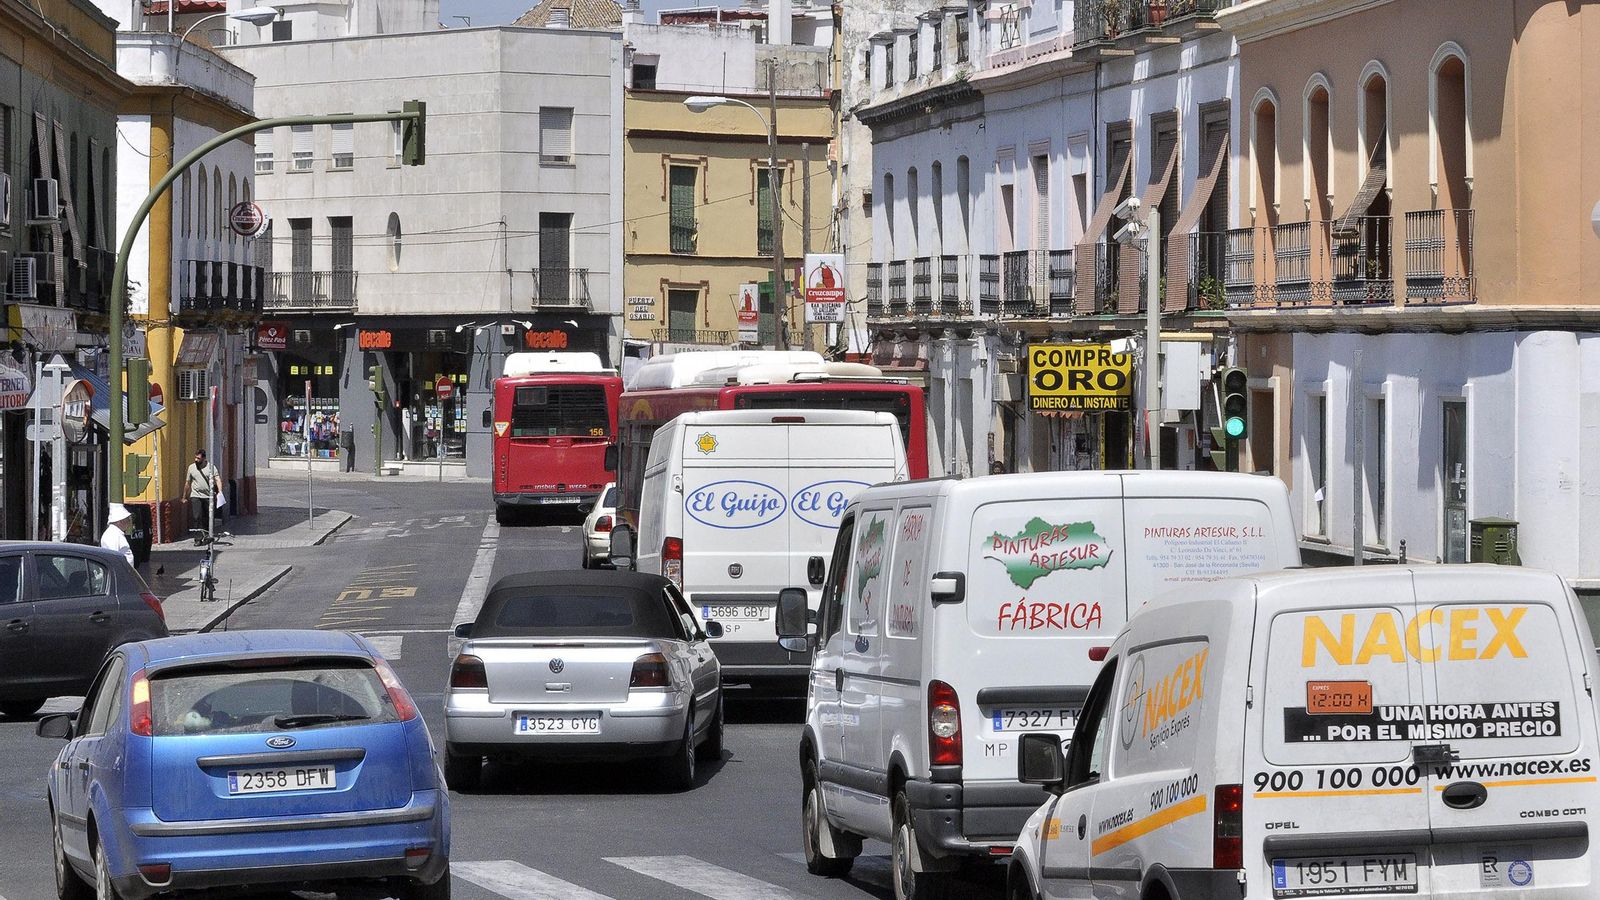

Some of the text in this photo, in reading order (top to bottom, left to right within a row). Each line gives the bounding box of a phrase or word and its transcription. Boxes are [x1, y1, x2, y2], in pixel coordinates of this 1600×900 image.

[808, 290, 844, 298] Cruzcampo
[360, 330, 392, 348] decalle
[526, 330, 568, 348] decalle
[1033, 350, 1127, 368] COMPRO
[0, 378, 25, 392] ERNET
[1035, 369, 1126, 390] ORO
[1033, 397, 1128, 408] DINERO AL INSTANTE
[589, 428, 604, 436] 156
[692, 492, 780, 518] El Guijo
[798, 492, 820, 512] El
[992, 525, 1069, 555] PINTURAS
[1144, 527, 1190, 538] PINTURAS
[1194, 526, 1238, 538] ARTESUR,
[1030, 544, 1098, 570] ARTESUR
[711, 606, 764, 617] 5696 GBY
[998, 596, 1102, 630] FÁBRICA
[1300, 607, 1528, 668] NACEX
[1142, 647, 1208, 739] NACEX
[1313, 694, 1368, 707] 12:00 H
[1005, 710, 1052, 728] 7327
[1060, 710, 1082, 727] FK
[1380, 702, 1556, 722] UNA HORA ANTES
[528, 718, 564, 730] 3523
[571, 718, 597, 730] GYG
[1150, 712, 1190, 750] Servicio Exprés
[1328, 725, 1371, 740] POR
[1377, 724, 1402, 740] EL
[1408, 722, 1477, 740] MISMO
[1482, 720, 1556, 738] PRECIO
[242, 770, 287, 790] 2358
[296, 768, 328, 786] DFW
[1254, 766, 1420, 792] 900 100 000
[1434, 758, 1590, 780] www.nacex.es
[1150, 773, 1198, 811] 900 100 000
[1098, 808, 1134, 834] www.nacex.es
[1520, 808, 1586, 818] COMBO CDTI
[1265, 822, 1300, 830] OPEL
[1296, 860, 1348, 884] 1951
[1363, 858, 1408, 882] FYM
